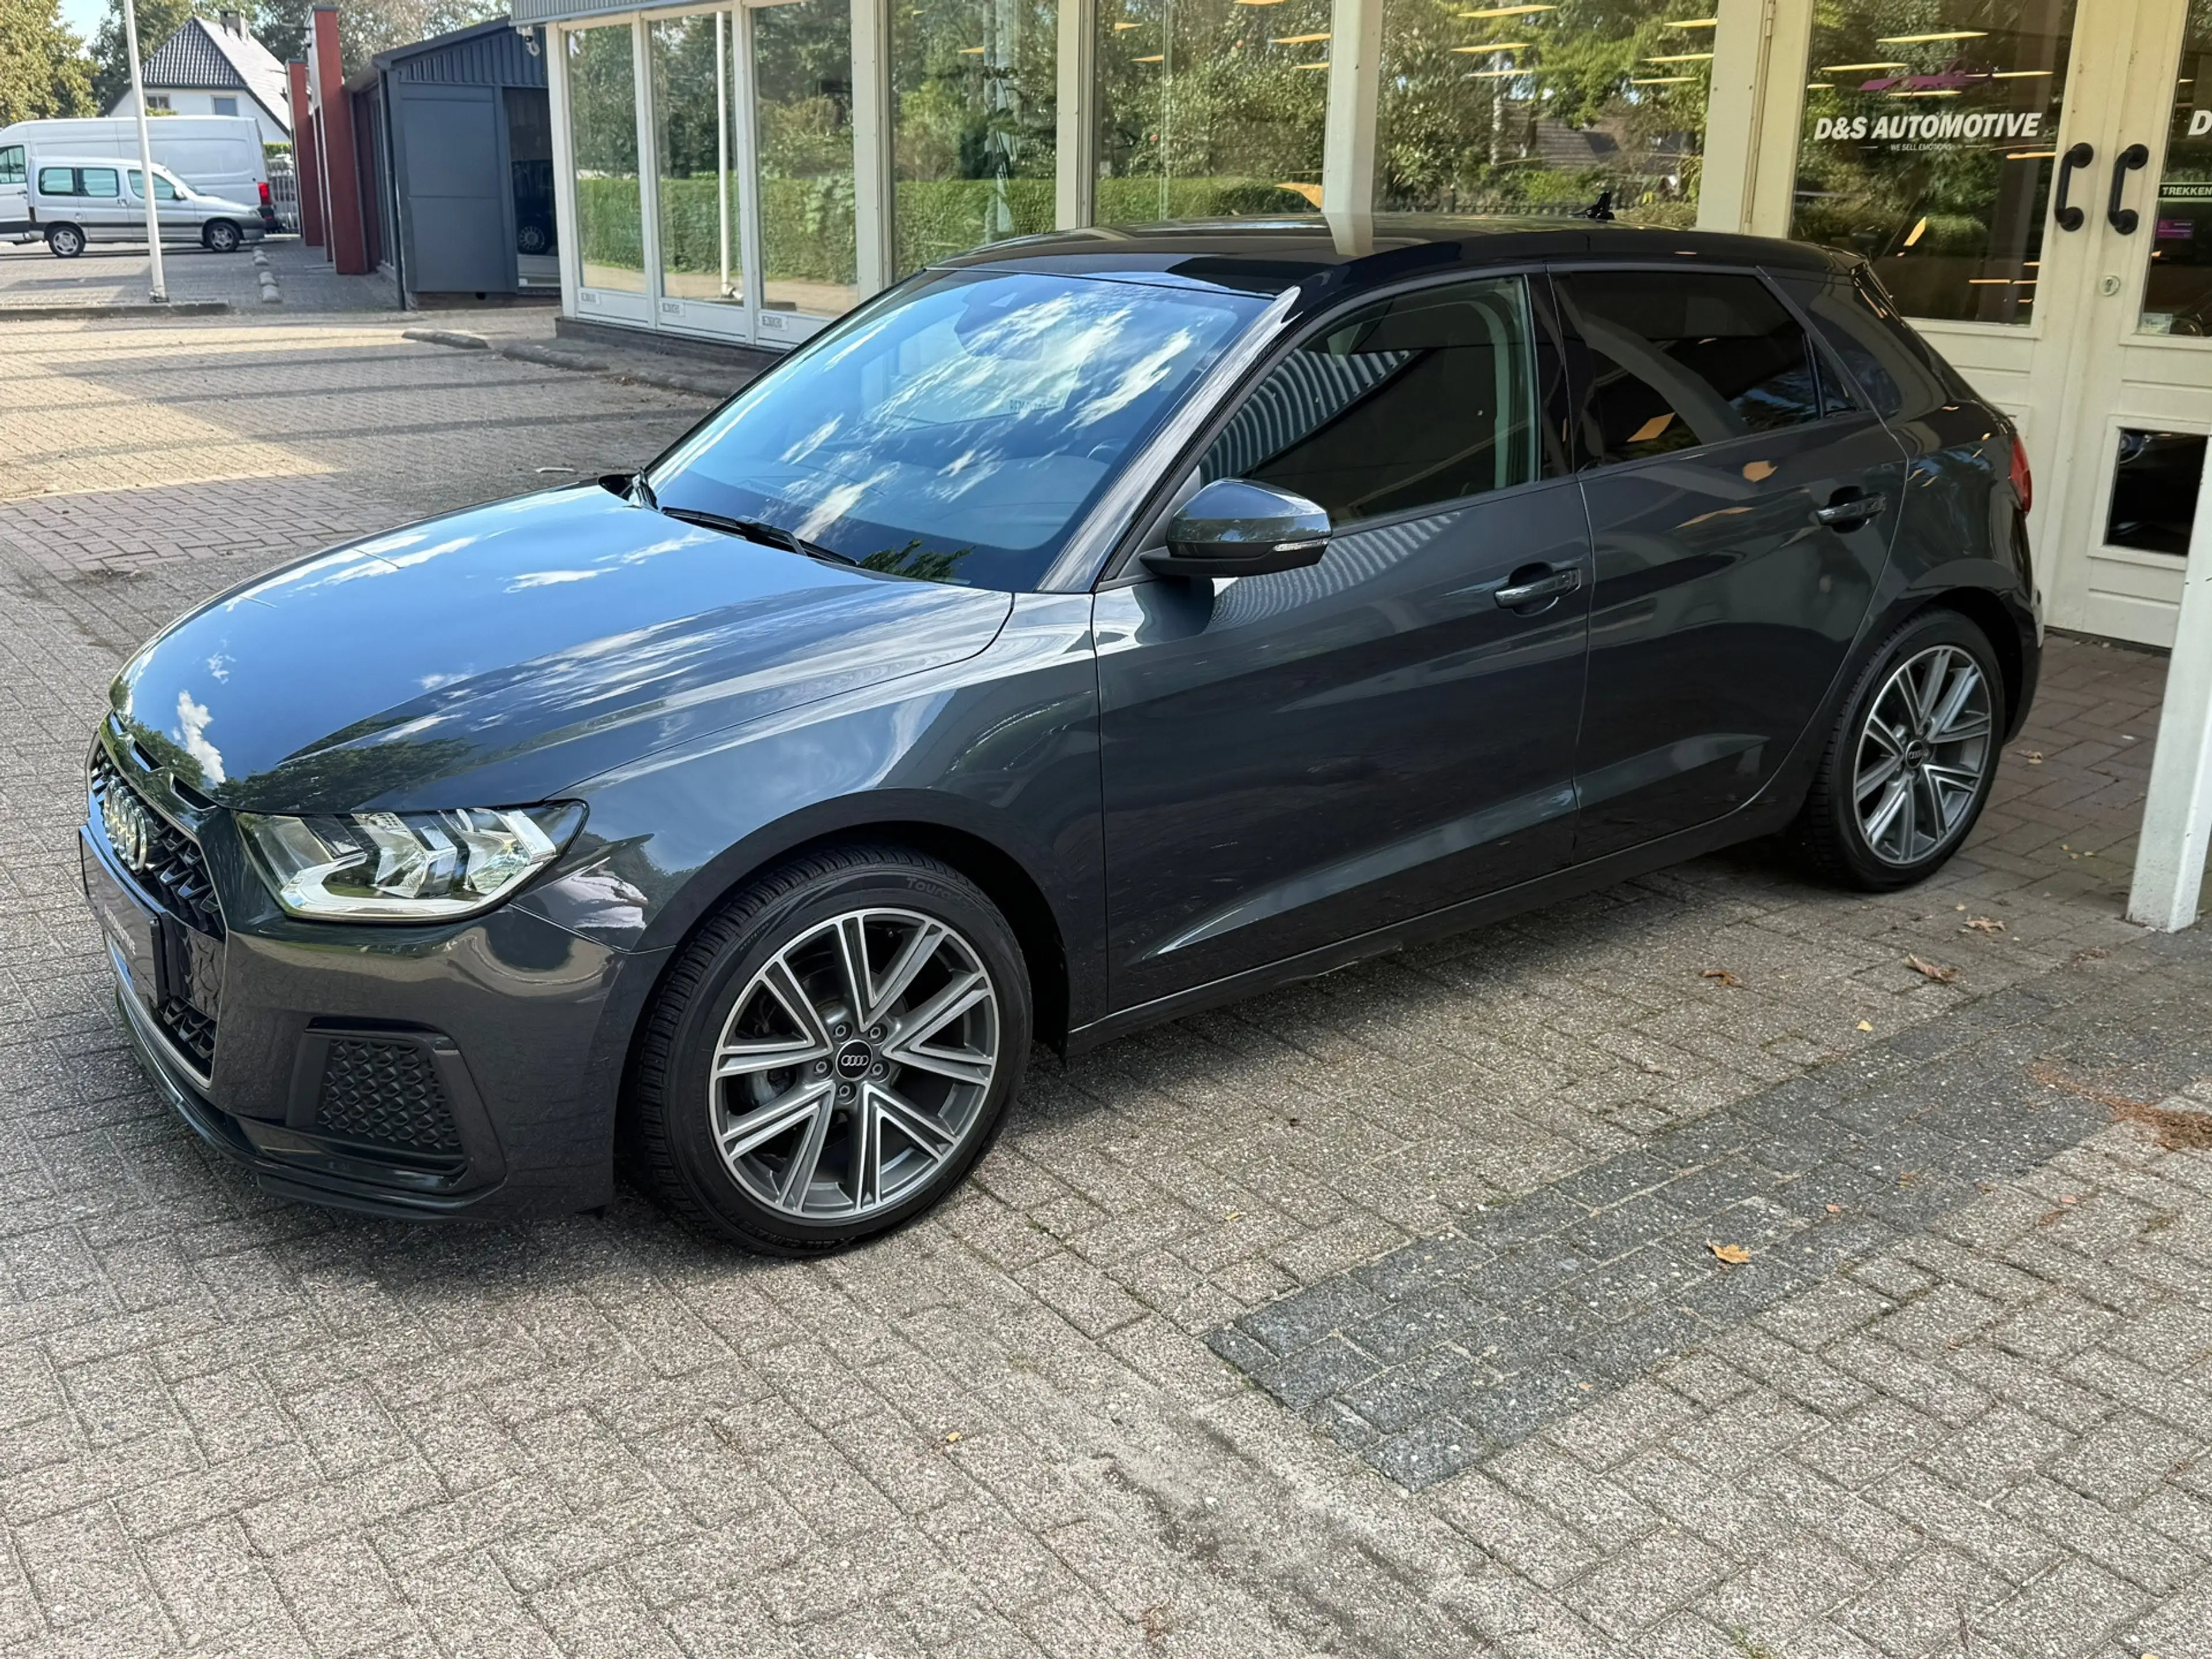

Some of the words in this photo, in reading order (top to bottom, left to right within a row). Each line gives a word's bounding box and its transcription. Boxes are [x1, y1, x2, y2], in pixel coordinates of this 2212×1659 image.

[1814, 116, 1868, 140] D&S
[1871, 112, 2043, 139] AUTOMOTIVE
[2162, 185, 2212, 196] TREKKEN
